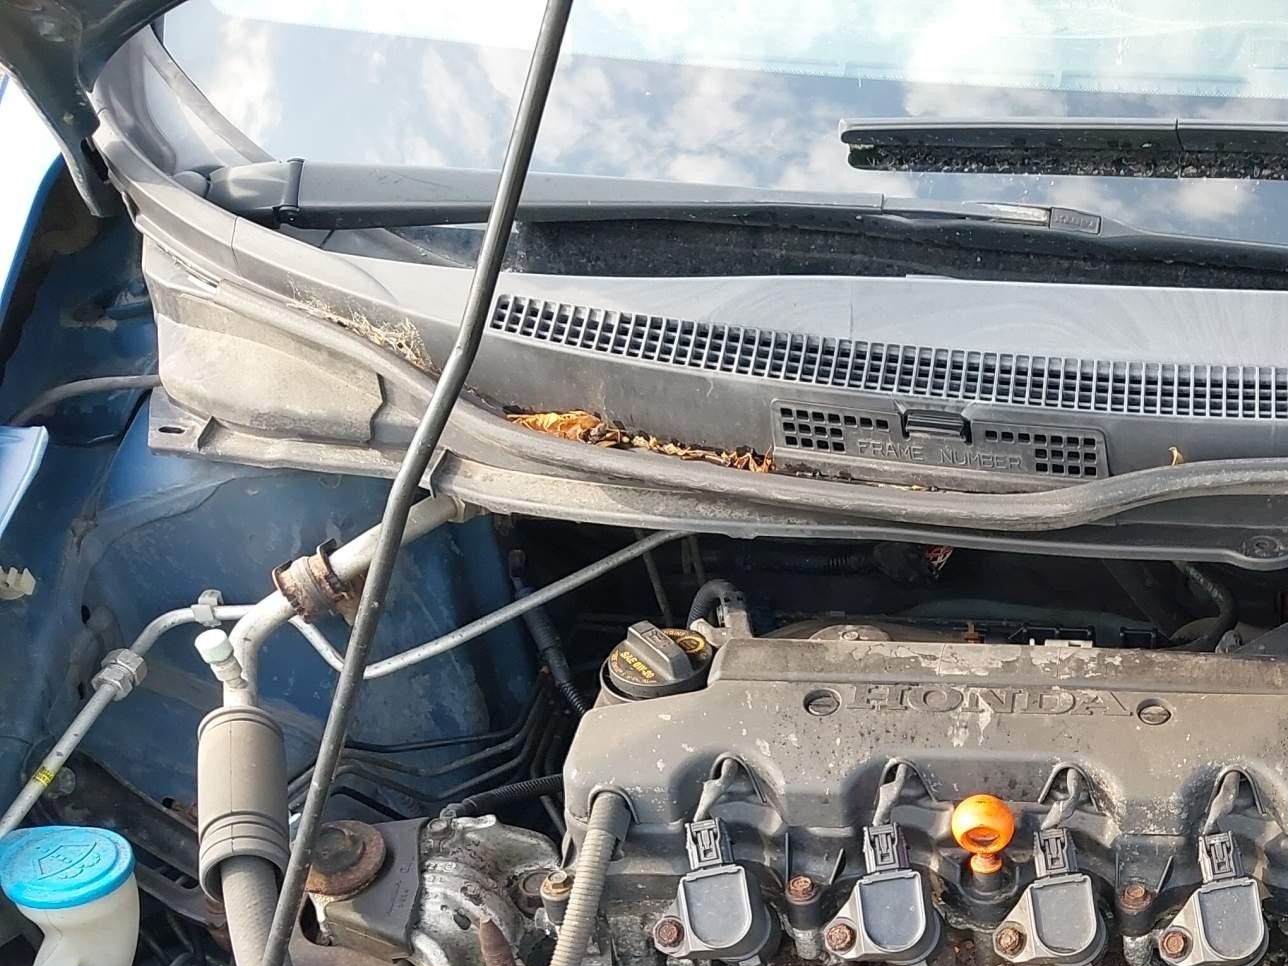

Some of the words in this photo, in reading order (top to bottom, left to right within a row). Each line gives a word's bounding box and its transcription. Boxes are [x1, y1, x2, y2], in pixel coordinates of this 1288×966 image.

[856, 438, 925, 462] FRAME
[939, 447, 1022, 472] NUMBER
[620, 651, 638, 665] SAE
[846, 684, 1132, 716] HONDA
